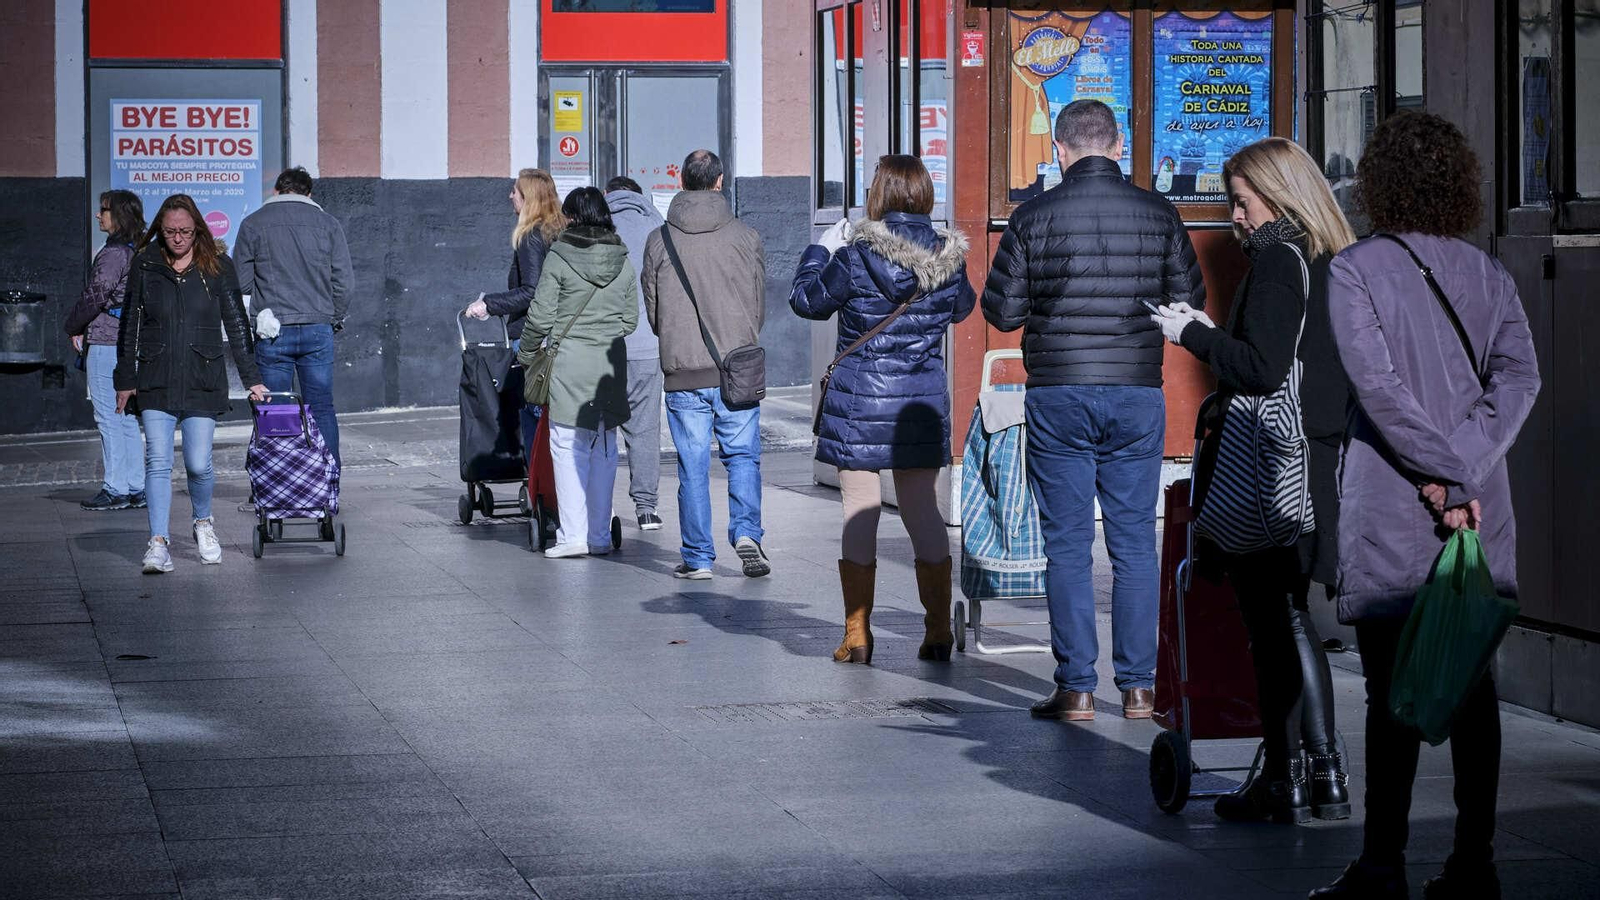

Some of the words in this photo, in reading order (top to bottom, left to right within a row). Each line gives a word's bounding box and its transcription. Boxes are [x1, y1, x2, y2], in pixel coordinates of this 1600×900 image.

[1191, 40, 1218, 50] TODA
[1222, 42, 1242, 50] UNA
[1170, 55, 1214, 63] HISTORIA
[1218, 55, 1263, 63] CANTADA
[1209, 68, 1226, 77] DEL
[1181, 81, 1252, 94] CARNAVAL
[1185, 102, 1201, 112] DE
[122, 106, 177, 128] BYE
[186, 106, 250, 128] BYE!
[1167, 121, 1183, 131] de
[1190, 121, 1219, 134] ayer
[1226, 120, 1235, 128] a
[118, 133, 253, 156] PARÁSITOS
[133, 172, 149, 181] AL
[151, 172, 193, 181] MEJOR
[196, 172, 240, 181] PRECIO
[144, 188, 150, 196] 2
[151, 188, 160, 196] al
[161, 188, 171, 196] 31
[211, 188, 222, 196] de
[224, 188, 245, 196] 2020
